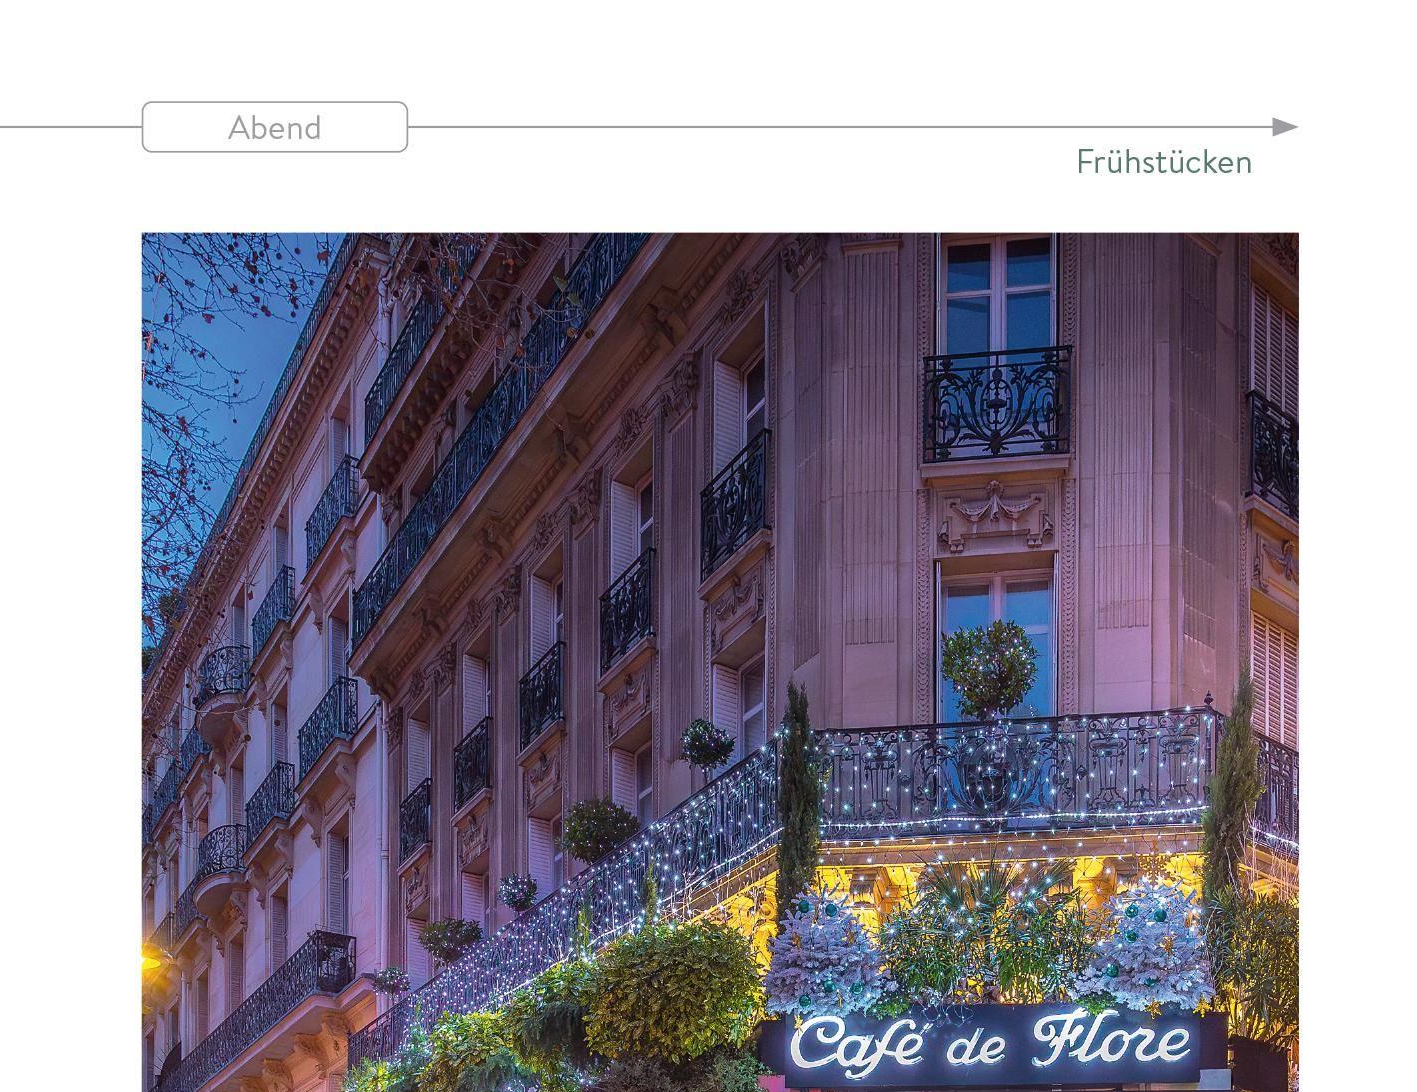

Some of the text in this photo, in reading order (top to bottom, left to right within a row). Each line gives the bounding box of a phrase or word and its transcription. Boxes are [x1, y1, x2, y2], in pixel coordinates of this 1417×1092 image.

[228, 114, 320, 140] Abend
[1078, 148, 1252, 174] Frühstücken
[790, 1005, 1192, 1080] Café de Flore
